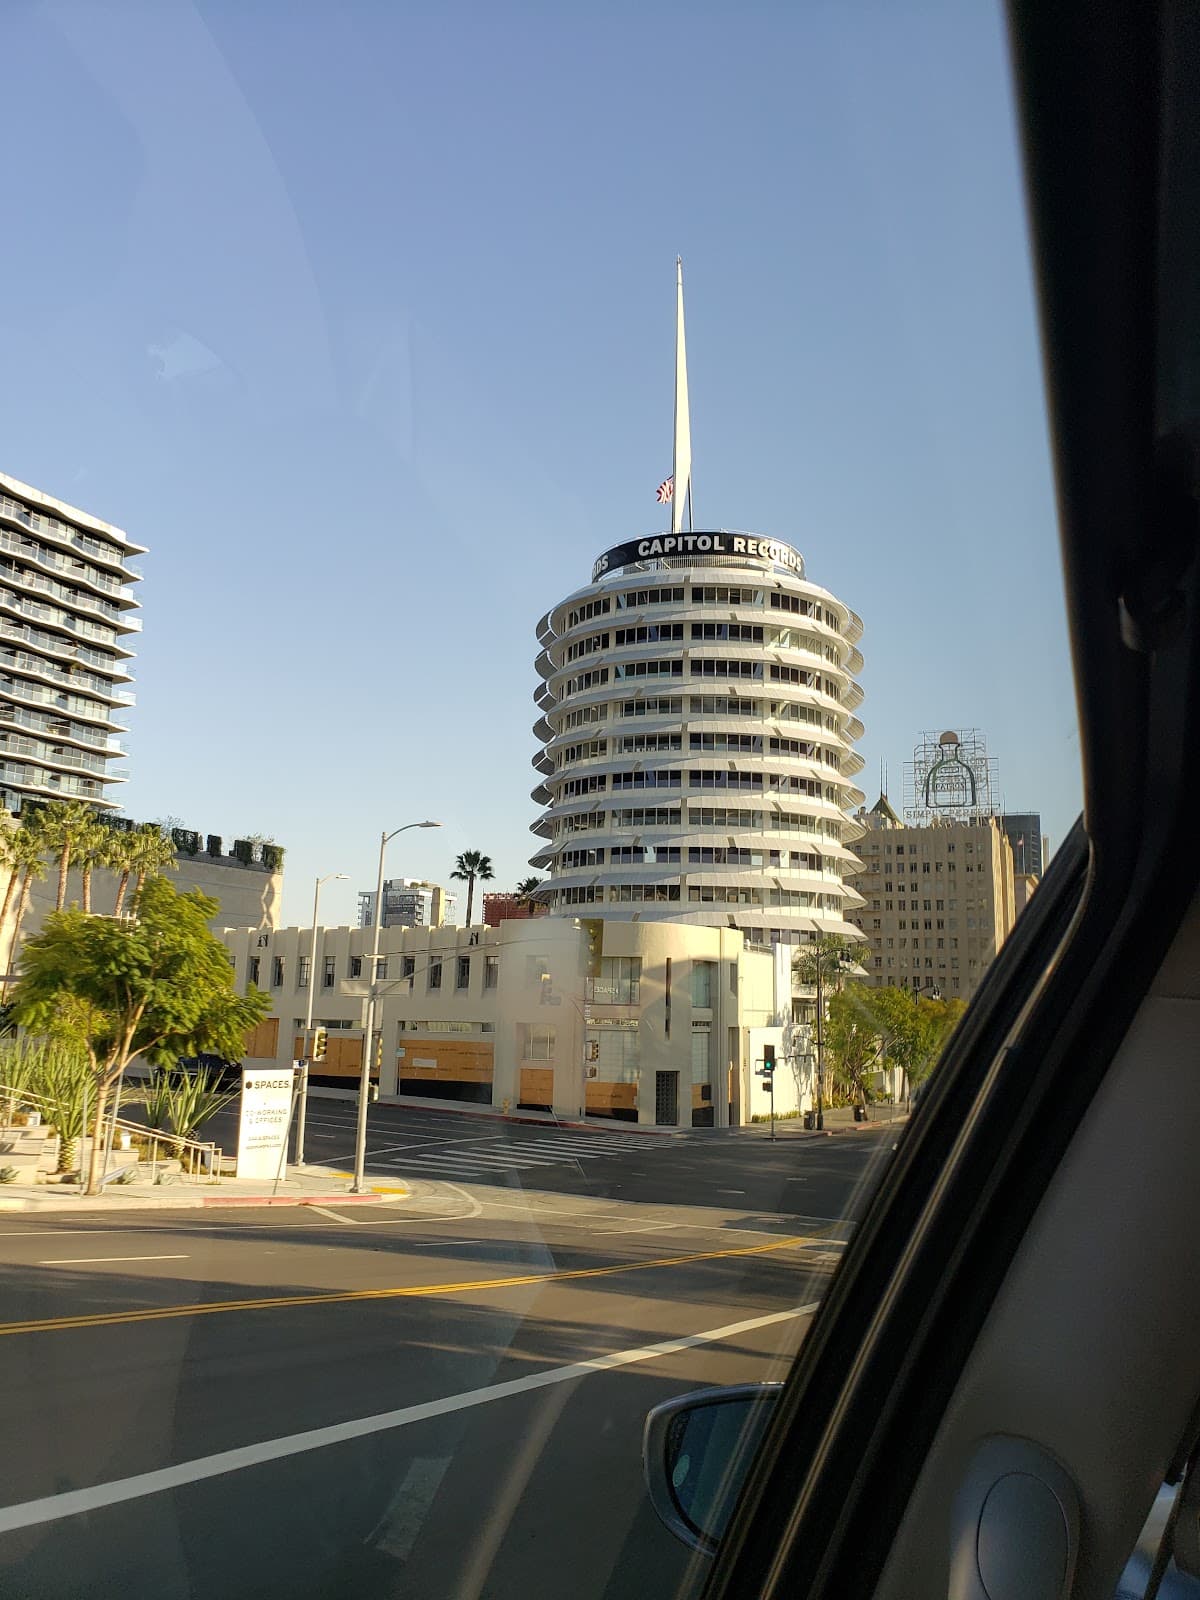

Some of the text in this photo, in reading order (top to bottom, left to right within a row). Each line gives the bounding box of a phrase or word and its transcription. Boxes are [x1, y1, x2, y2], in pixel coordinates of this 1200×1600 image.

[638, 535, 802, 572] CAPITOL RECORDS
[906, 809, 945, 819] SIMPLY
[254, 1080, 290, 1089] SPACES
